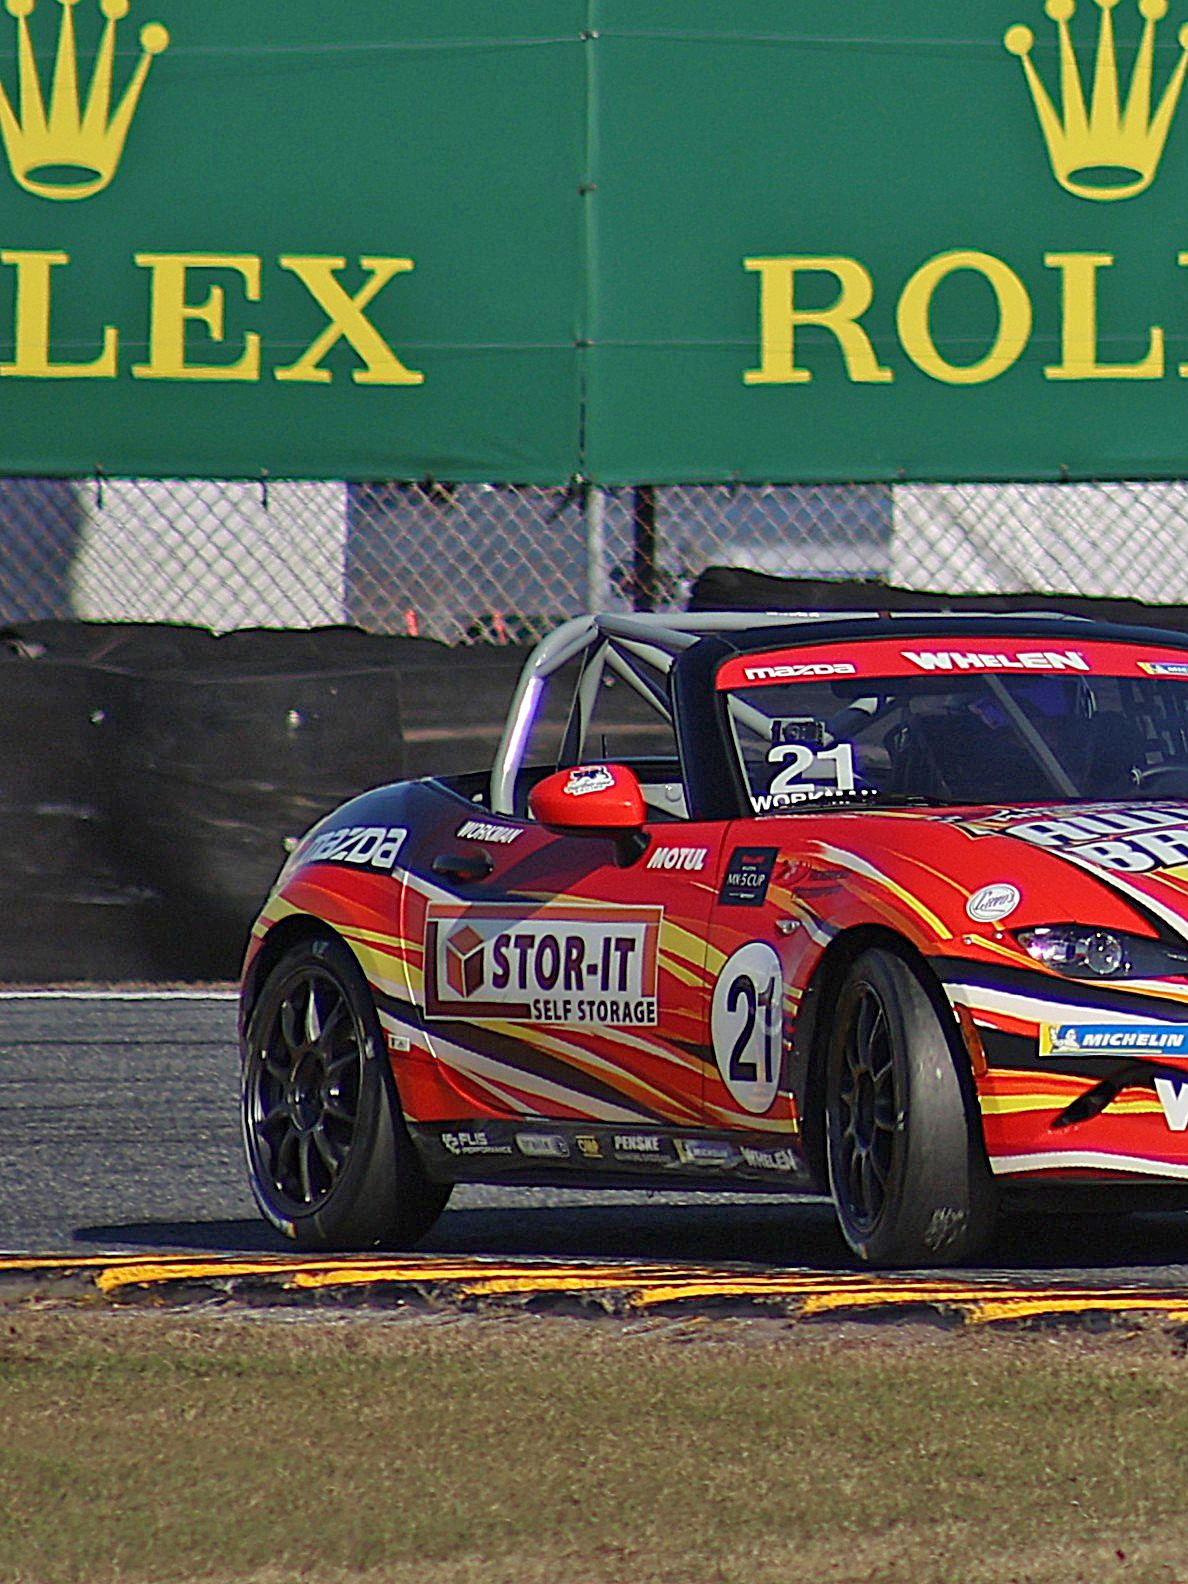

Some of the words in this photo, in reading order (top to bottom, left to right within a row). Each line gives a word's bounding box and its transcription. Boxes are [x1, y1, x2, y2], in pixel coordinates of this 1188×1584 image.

[901, 651, 1090, 671] WHELEN
[768, 743, 854, 794] 21
[457, 821, 525, 844] WORKMAN
[646, 847, 708, 870] MOTUL
[748, 874, 766, 887] CUP
[493, 934, 636, 991] STOR-IT
[534, 999, 571, 1021] SELF
[578, 1001, 656, 1023] STORAGE
[726, 974, 776, 1083] 21
[1082, 1033, 1184, 1047] MICHELIN
[458, 1132, 488, 1145] FLIS
[614, 1135, 660, 1151] PENSKE
[739, 1146, 798, 1171] WHELEN
